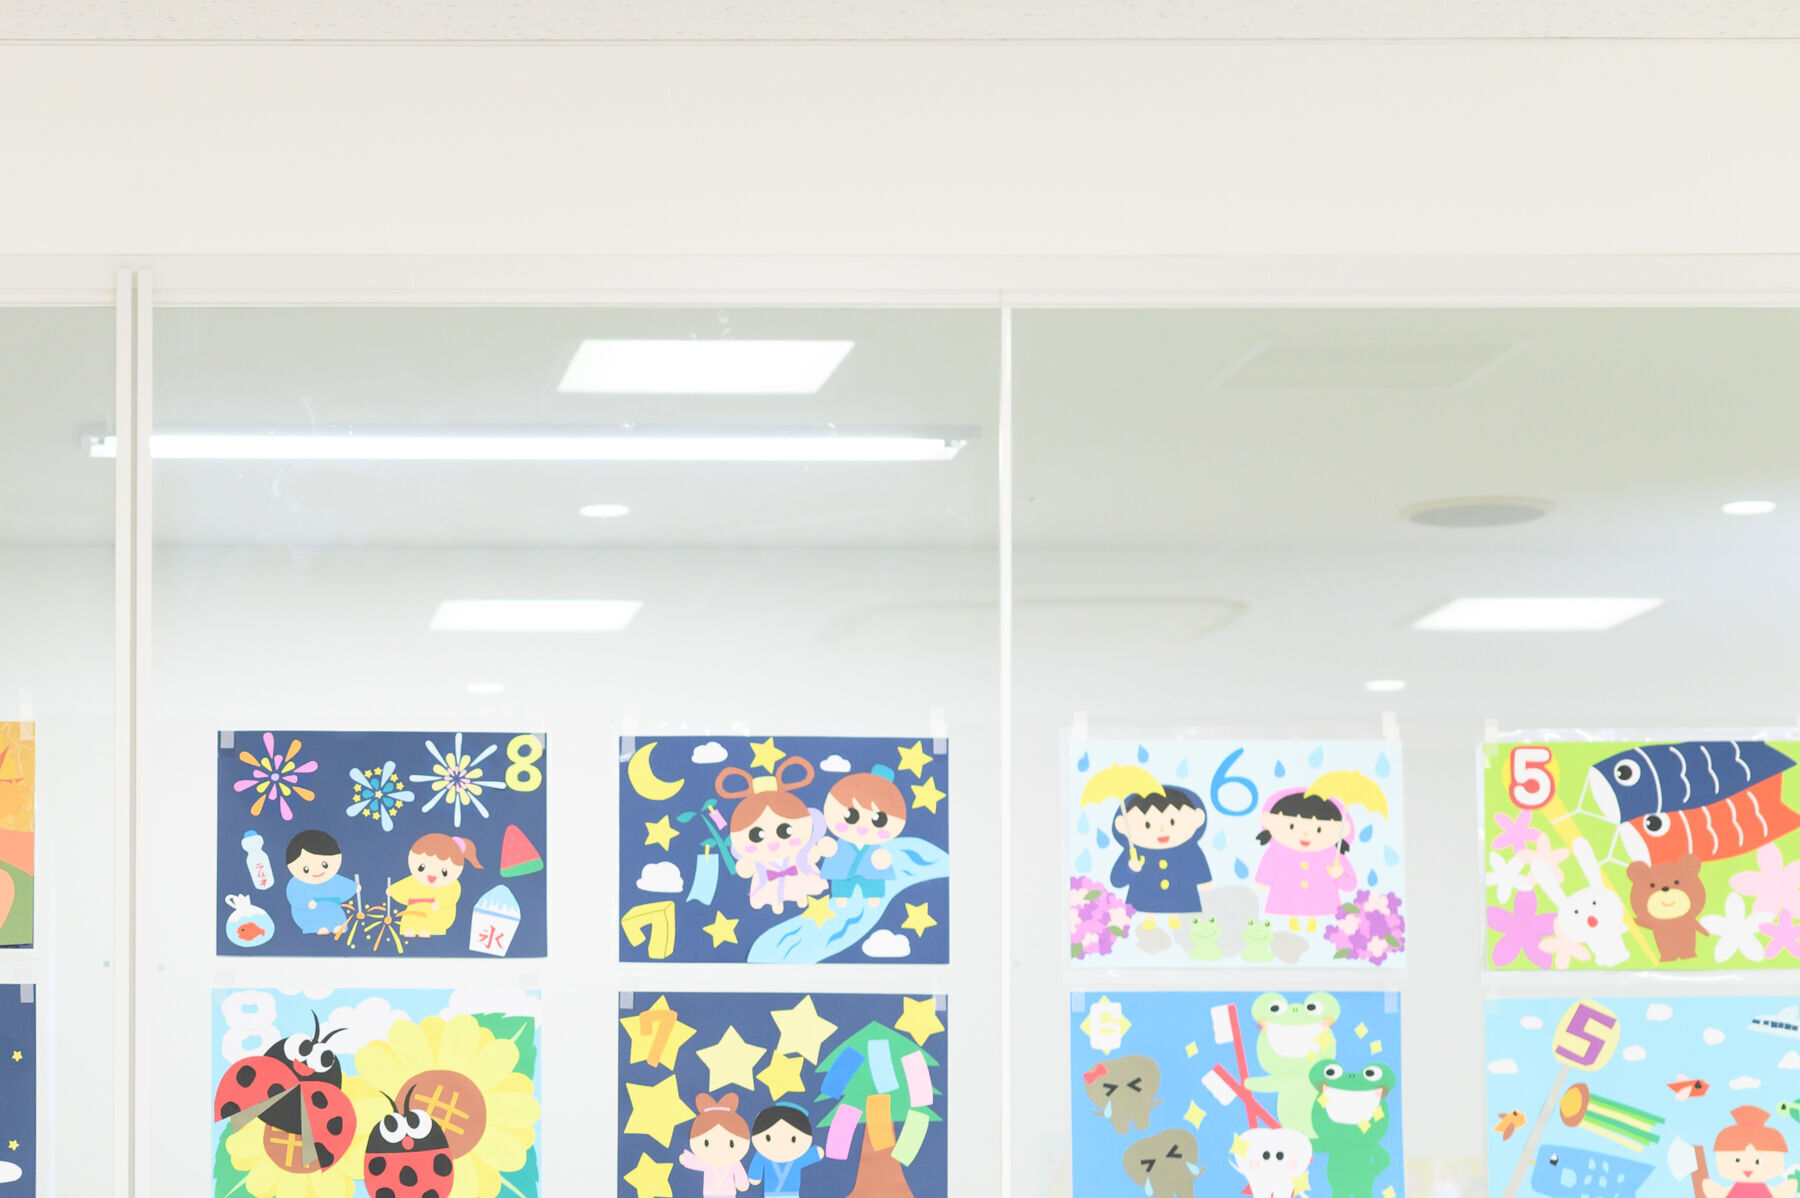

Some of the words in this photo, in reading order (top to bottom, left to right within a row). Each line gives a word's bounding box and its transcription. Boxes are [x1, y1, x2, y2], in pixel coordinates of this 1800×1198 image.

[505, 734, 543, 793] 8
[1210, 747, 1259, 817] 6
[1509, 745, 1556, 810] 5
[477, 924, 506, 950] 氷
[621, 900, 676, 960] 7
[221, 989, 281, 1064] 8
[638, 1009, 678, 1069] 7
[1555, 1003, 1617, 1066] 5
